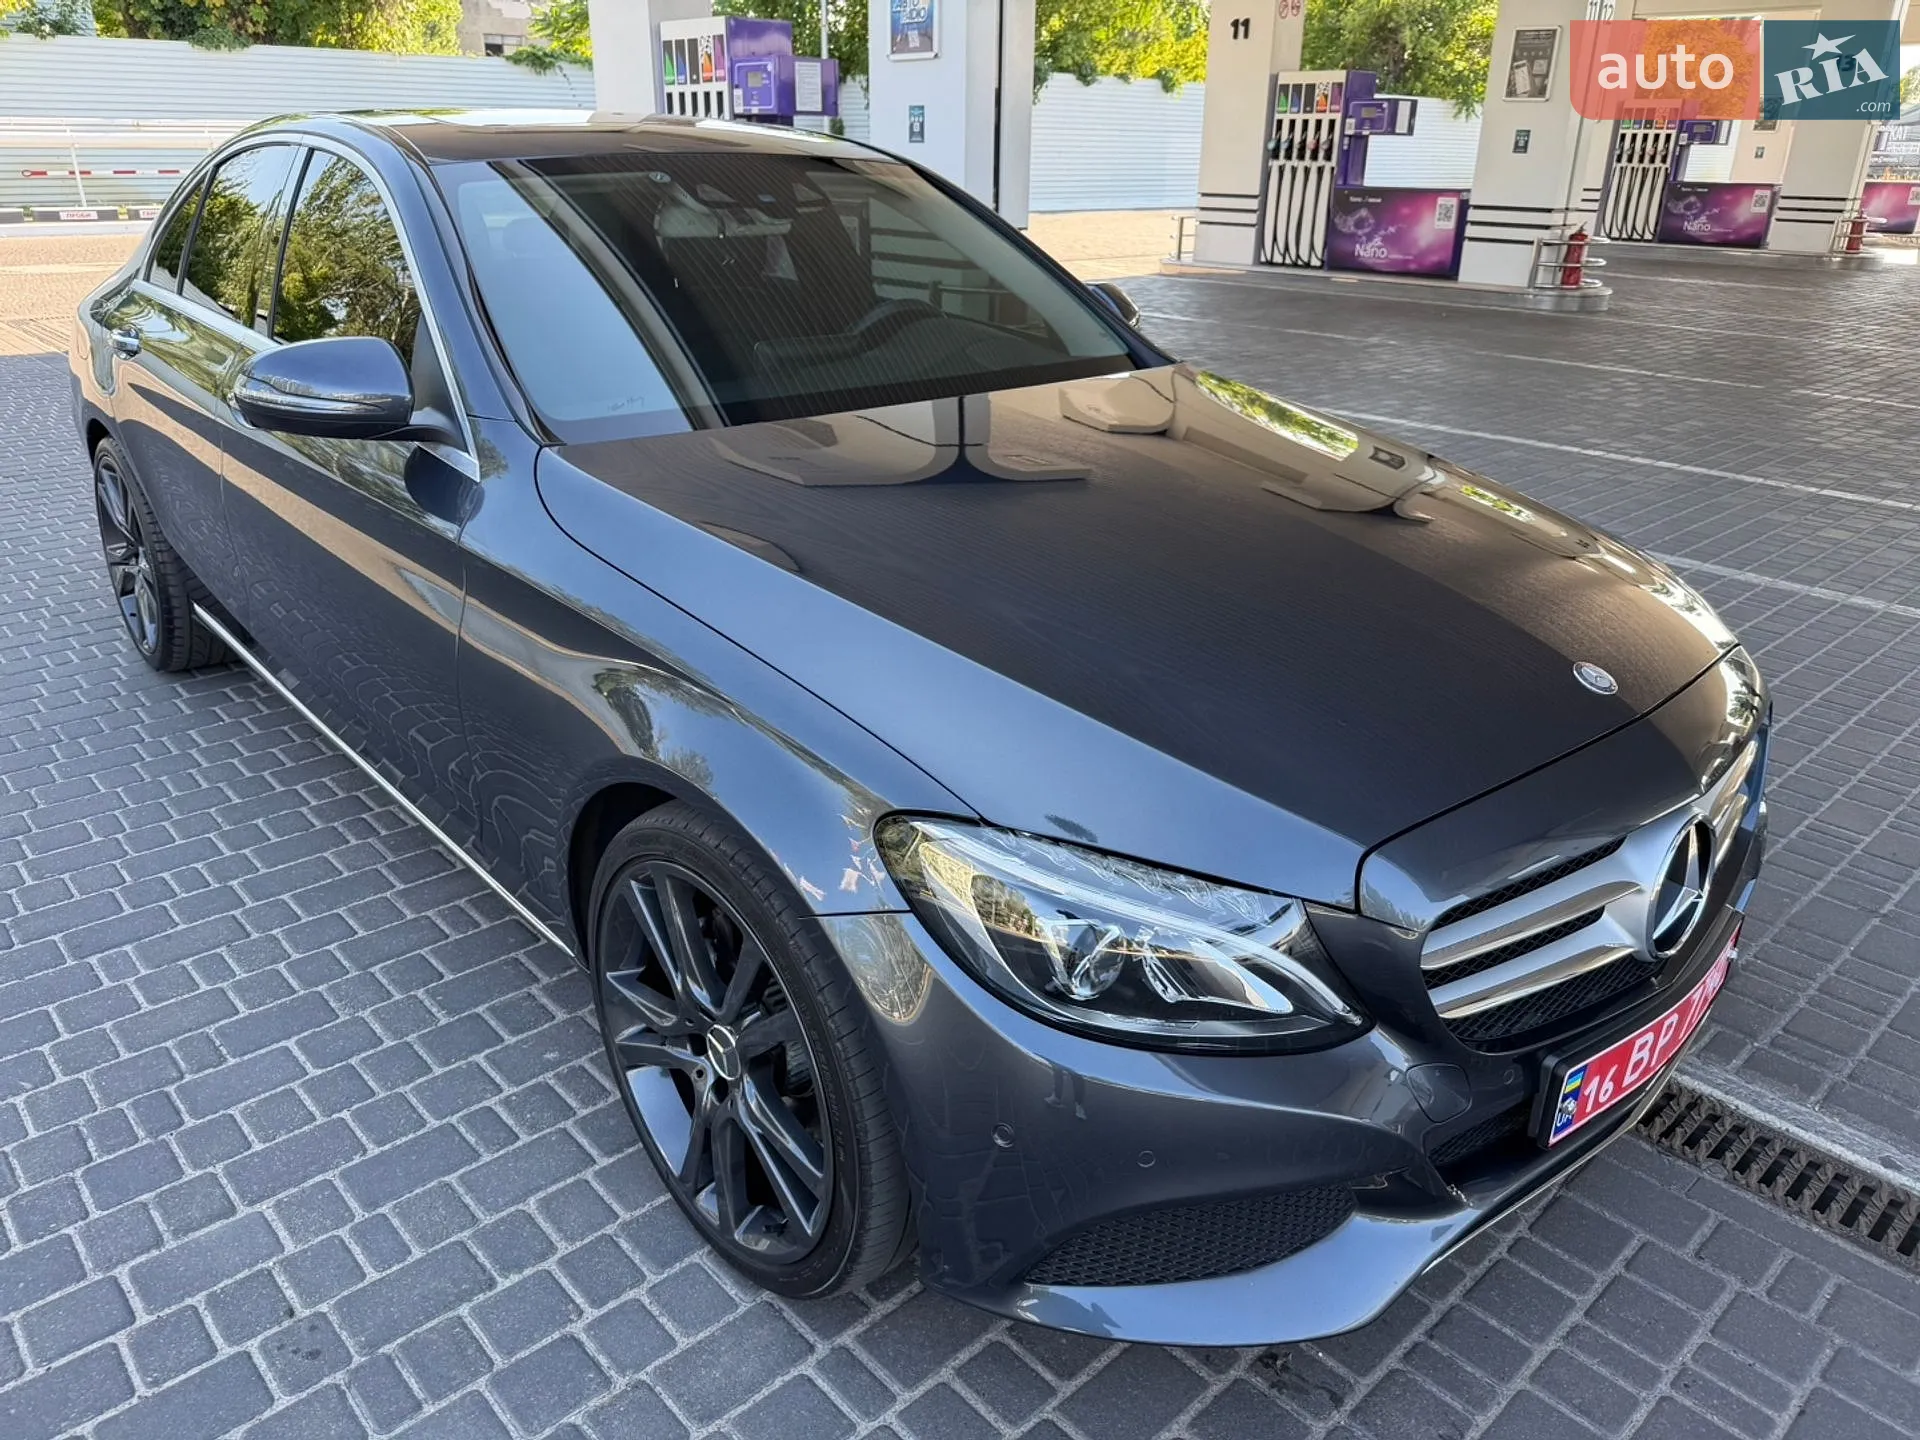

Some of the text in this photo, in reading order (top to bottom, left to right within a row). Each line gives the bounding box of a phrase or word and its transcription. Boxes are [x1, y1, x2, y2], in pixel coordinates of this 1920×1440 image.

[1230, 18, 1250, 40] 11
[1683, 220, 1711, 232] Nano
[1354, 243, 1388, 258] Nano
[1584, 1064, 1619, 1113] 16
